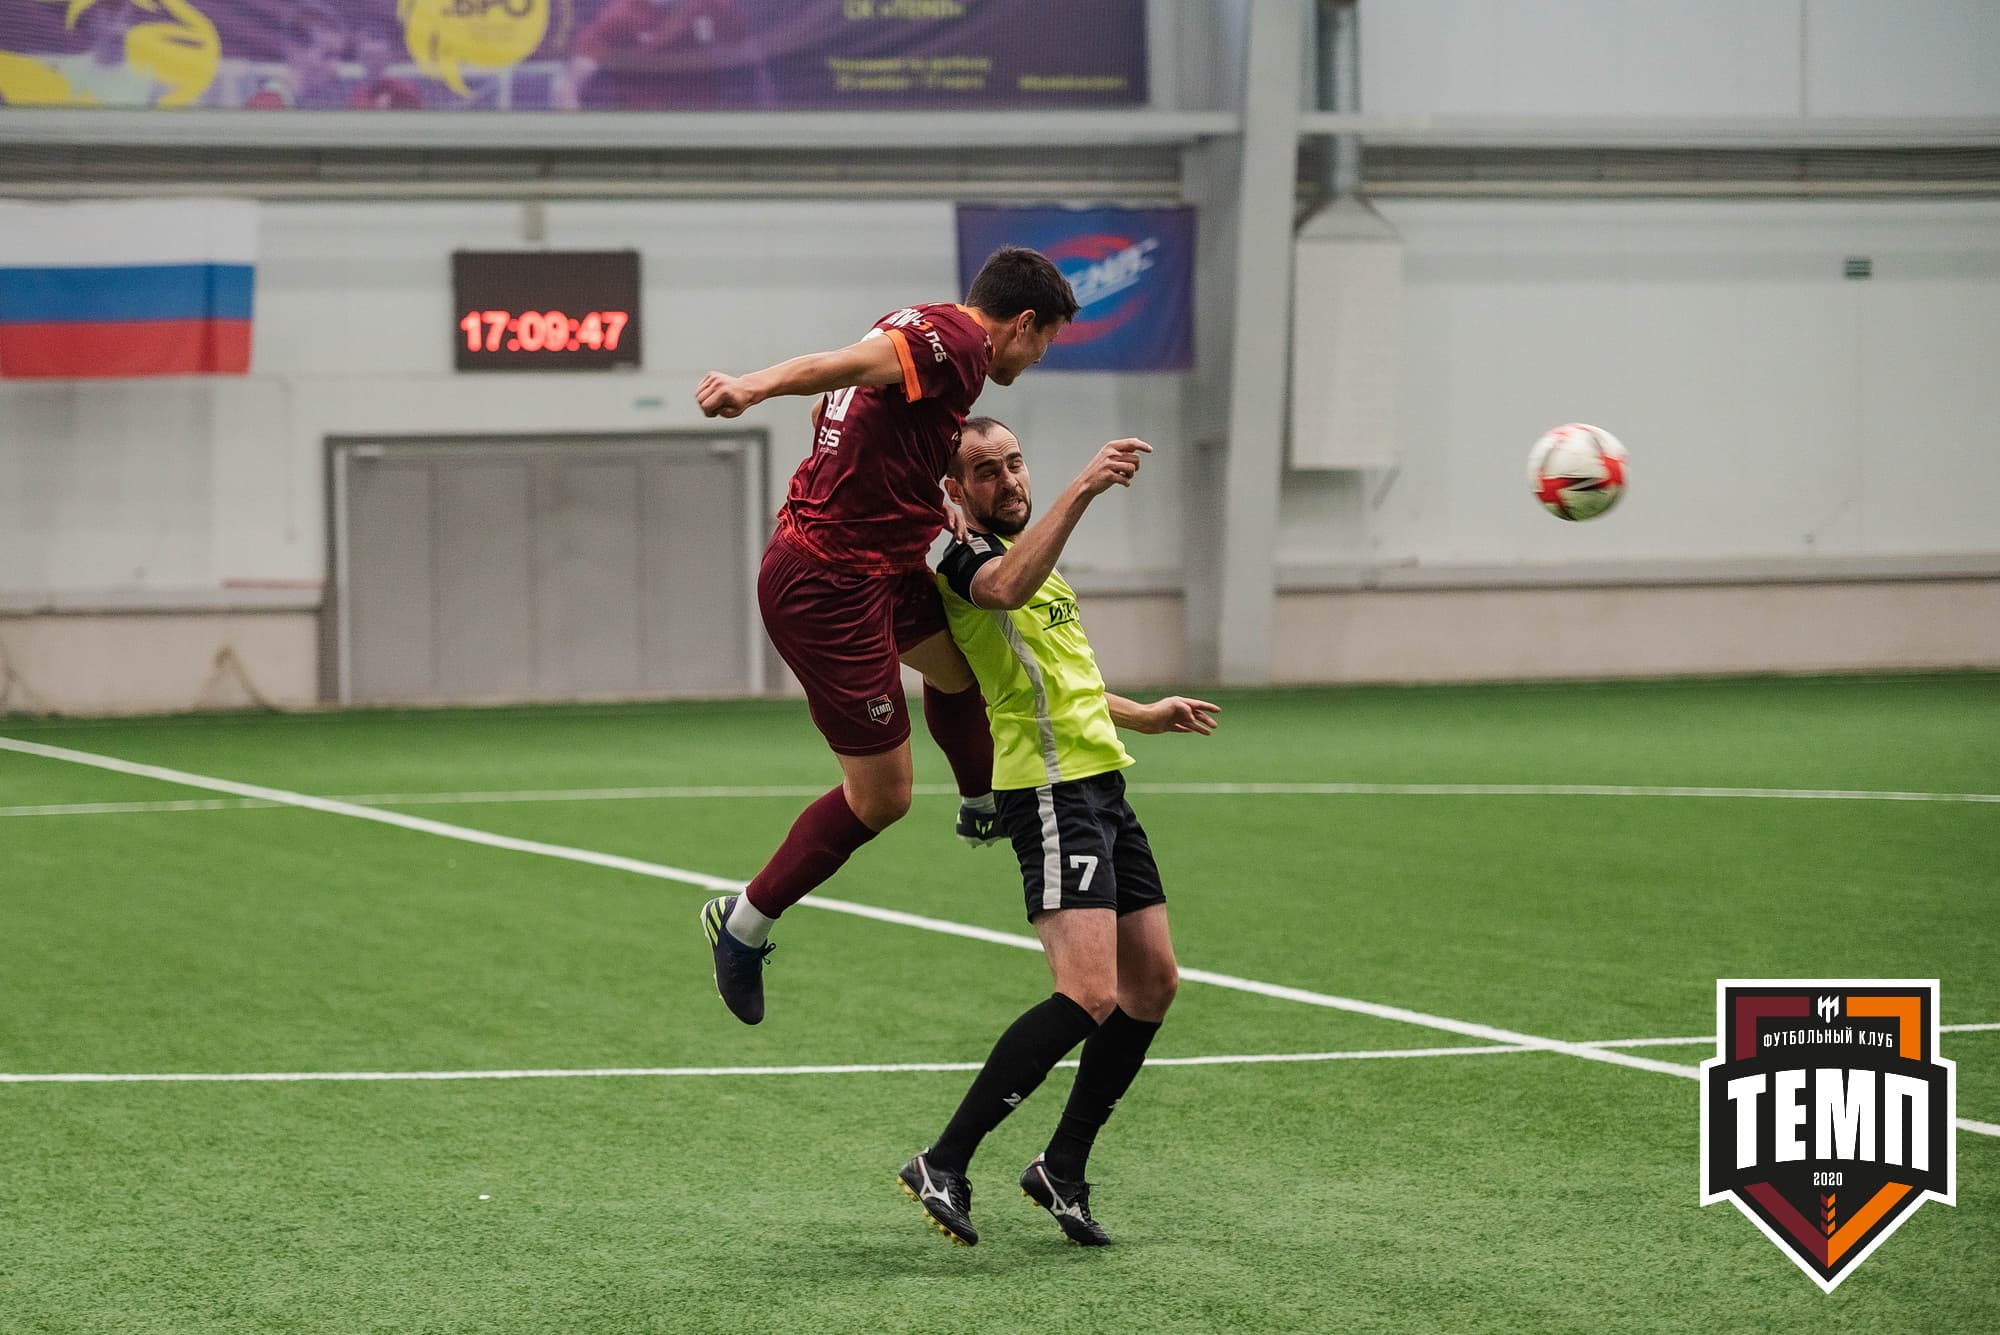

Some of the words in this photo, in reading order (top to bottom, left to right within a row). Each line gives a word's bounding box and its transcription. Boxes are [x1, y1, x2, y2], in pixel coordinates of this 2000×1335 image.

[461, 311, 628, 351] 17:09:47
[871, 703, 891, 717] ТЕМП
[1069, 855, 1098, 891] 7
